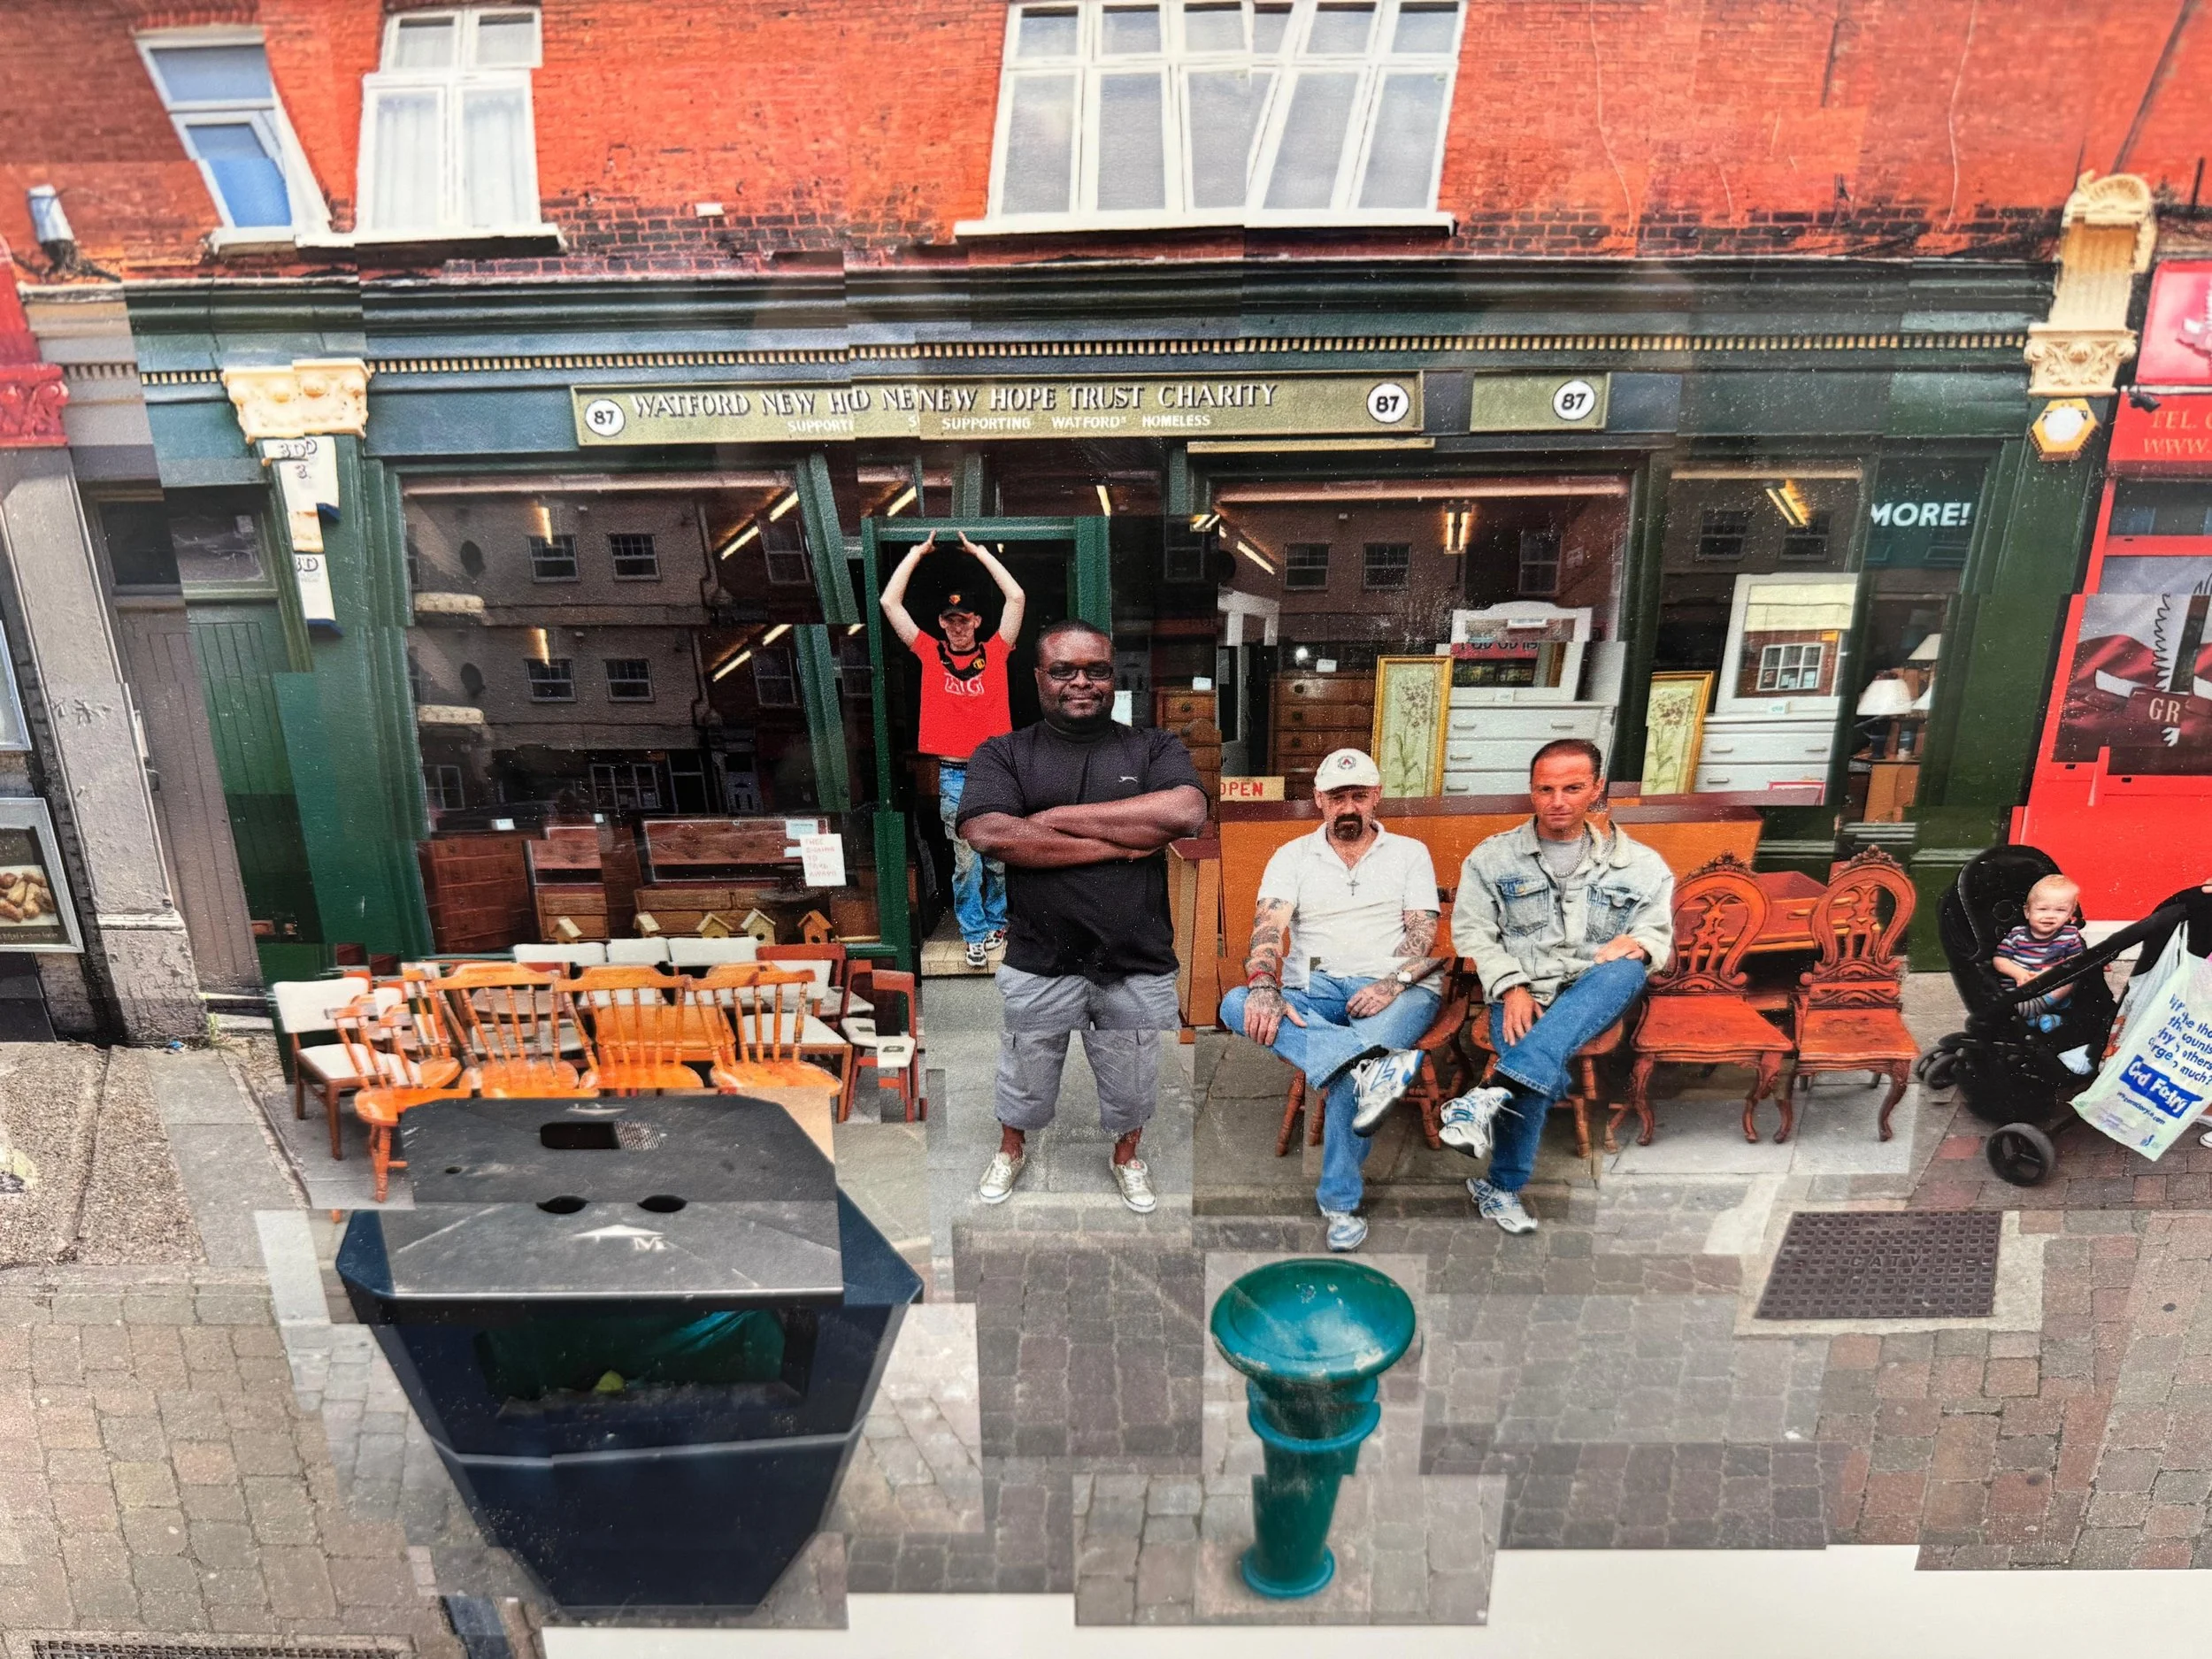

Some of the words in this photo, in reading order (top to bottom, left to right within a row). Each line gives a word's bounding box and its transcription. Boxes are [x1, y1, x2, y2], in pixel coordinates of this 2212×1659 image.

[630, 391, 751, 419] WATFORD
[761, 388, 817, 417] NEW
[918, 387, 979, 412] NEW
[989, 386, 1057, 411] HOPE
[1066, 385, 1146, 410] TRUST
[1157, 382, 1279, 409] CHARITY
[1375, 395, 1401, 414] 87
[1561, 392, 1587, 411] 87
[594, 410, 616, 426] 87
[941, 415, 1031, 431] SUPPORTING
[1141, 413, 1211, 428] HOMELESS
[1870, 502, 1972, 527] MORE!
[2149, 697, 2182, 723] GR
[1220, 781, 1263, 796] OPEN
